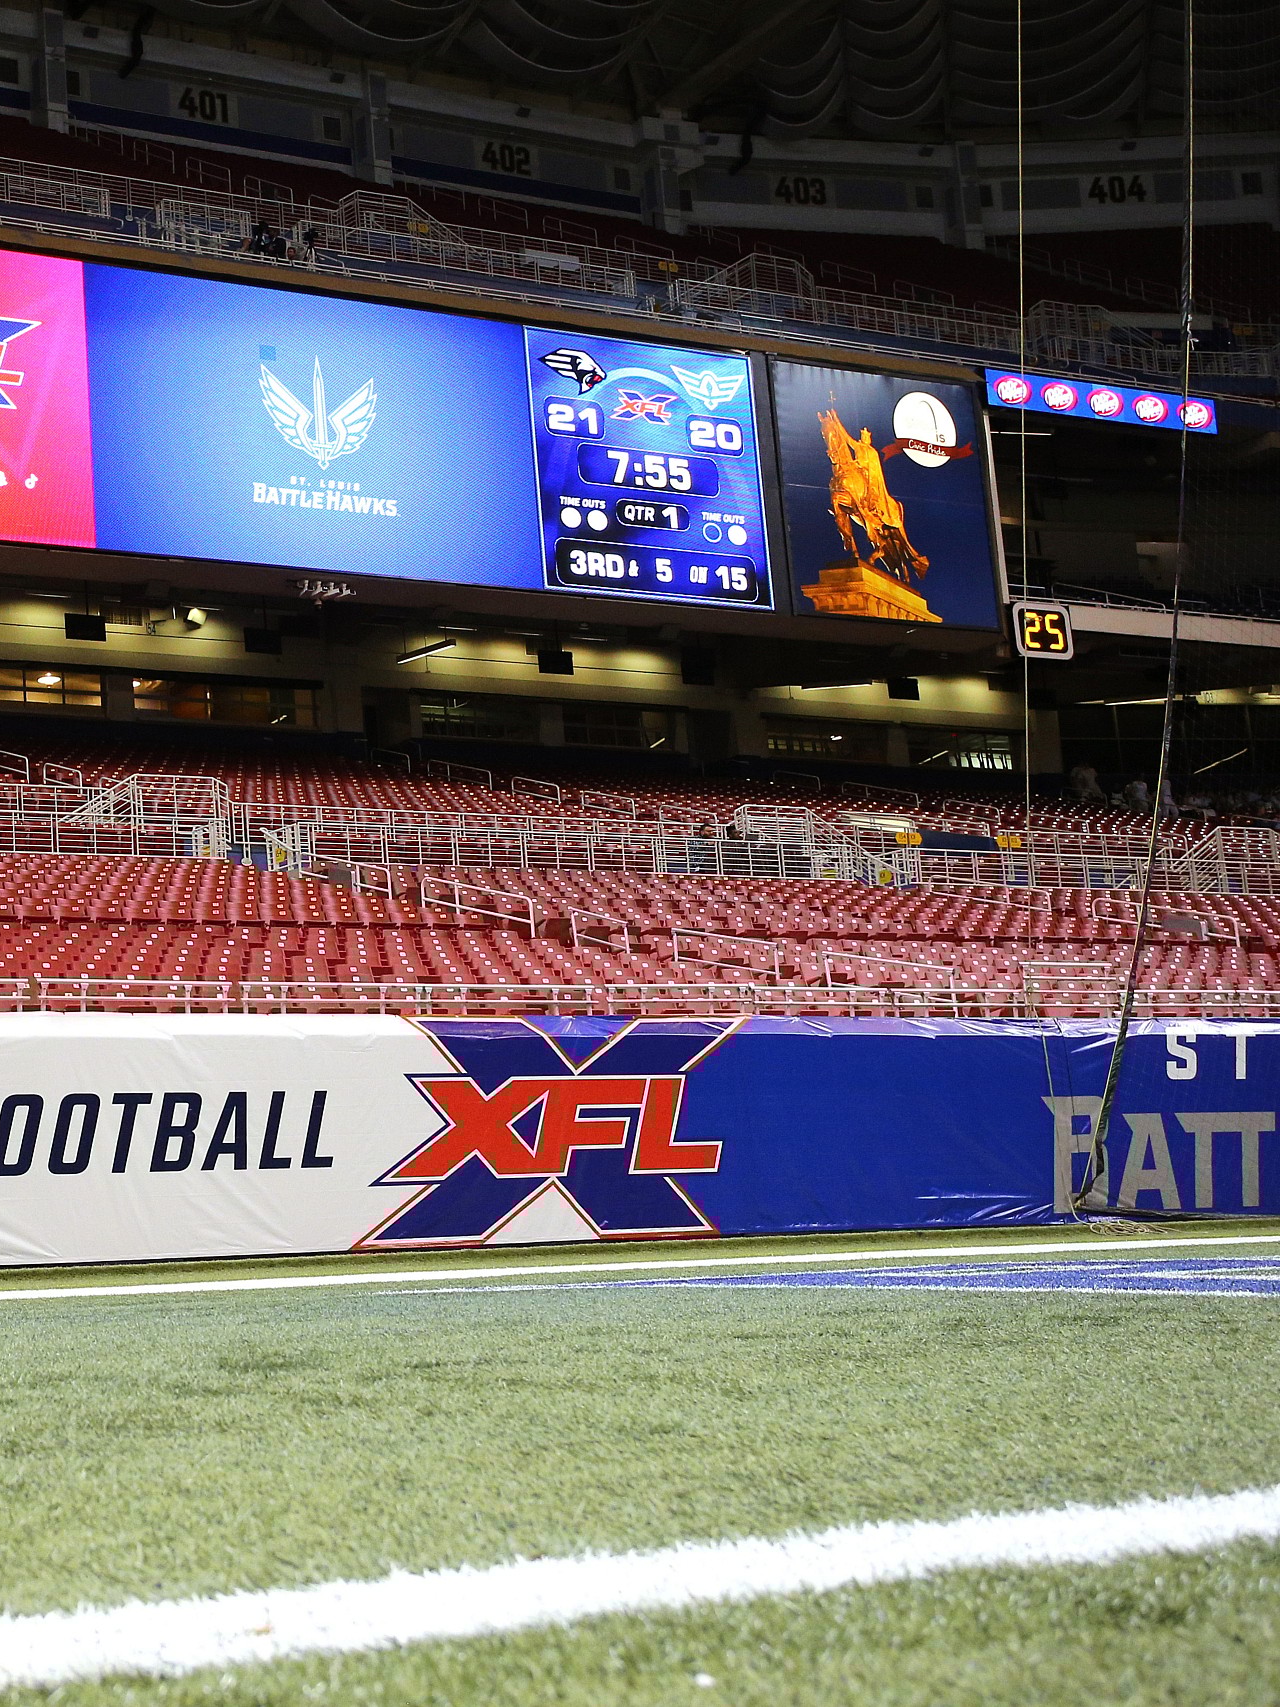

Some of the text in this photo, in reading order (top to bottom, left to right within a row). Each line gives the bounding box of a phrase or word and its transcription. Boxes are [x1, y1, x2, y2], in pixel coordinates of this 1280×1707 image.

[179, 87, 228, 123] 401
[482, 141, 531, 176] 402
[775, 176, 826, 206] 403
[1088, 175, 1146, 204] 404
[547, 403, 598, 434] 21
[689, 420, 742, 450] 20
[607, 450, 692, 491] 7:55
[559, 496, 606, 509] TIME OUTS
[624, 505, 679, 529] QTR 1
[702, 511, 746, 525] TIME OUTS
[569, 549, 625, 579] 3RD
[655, 558, 673, 583] 5
[715, 565, 748, 592] 15
[1025, 611, 1065, 651] 25
[368, 1073, 723, 1187] XFL
